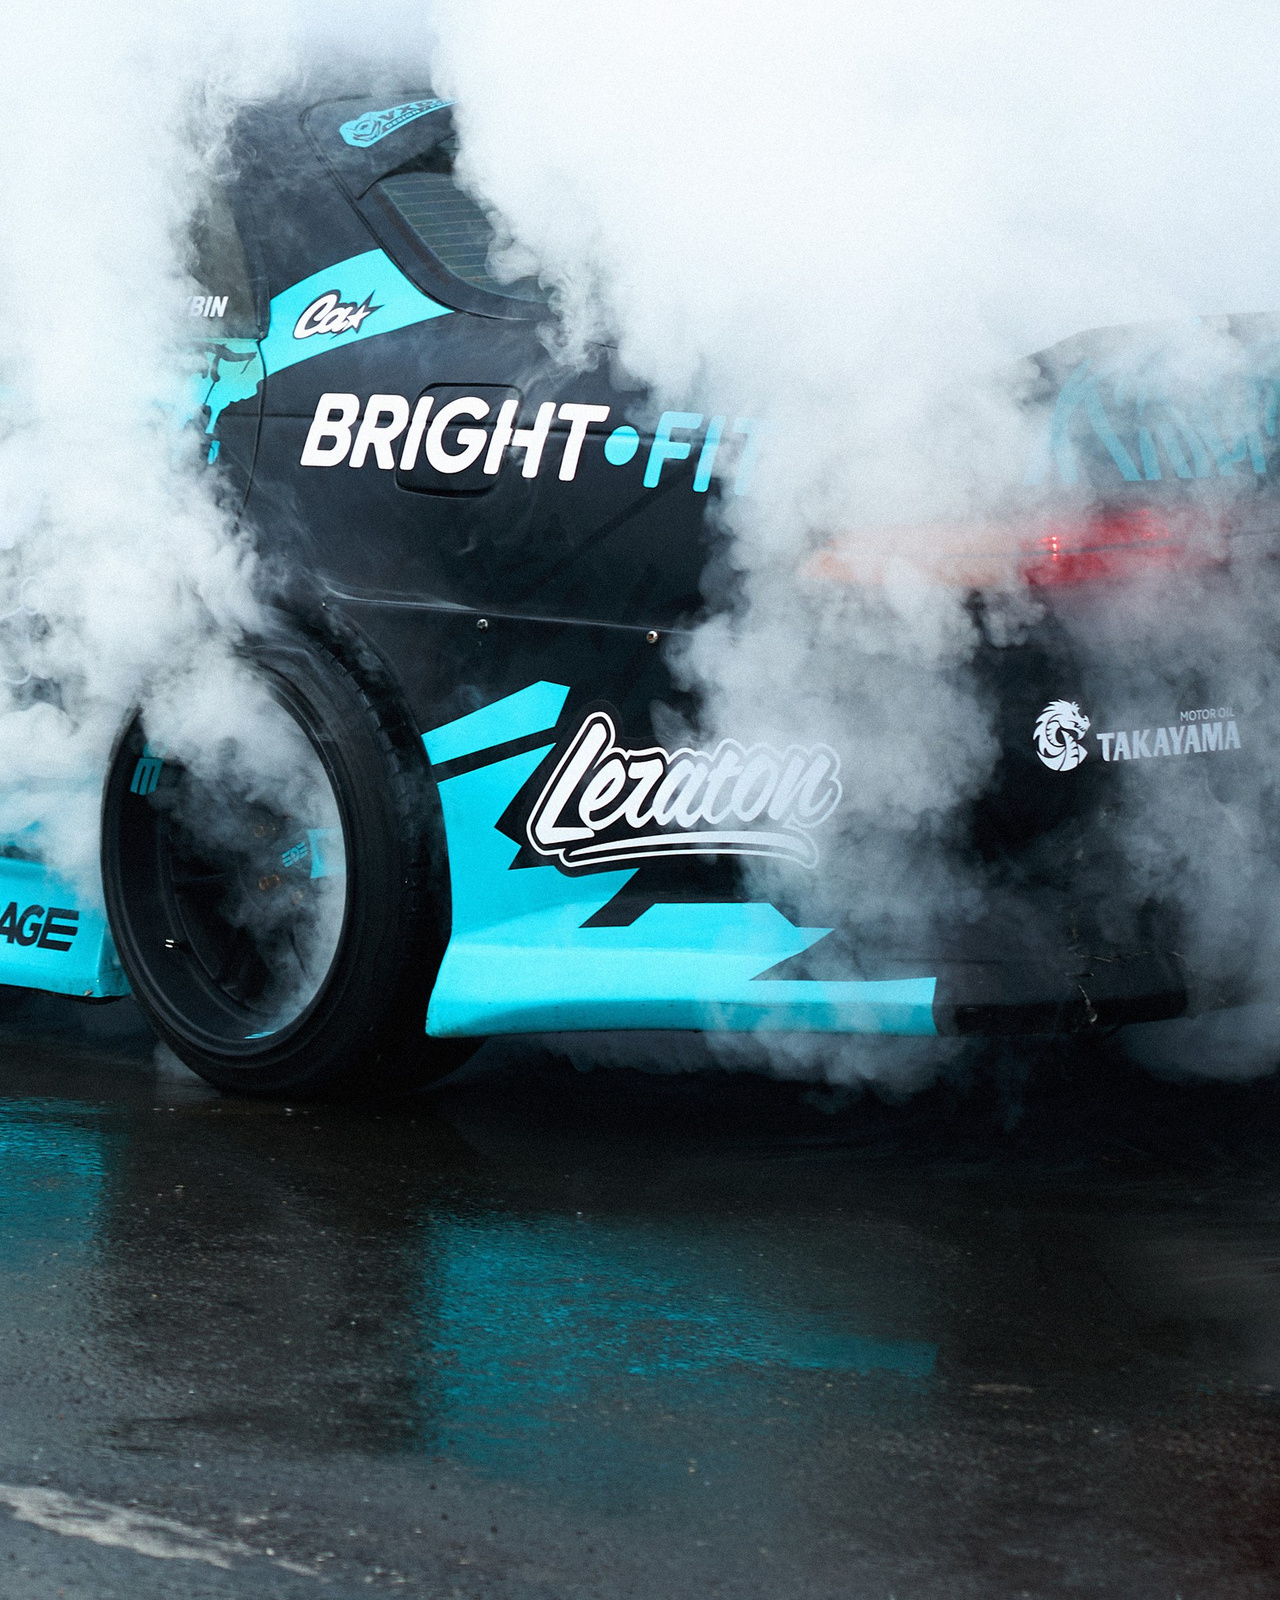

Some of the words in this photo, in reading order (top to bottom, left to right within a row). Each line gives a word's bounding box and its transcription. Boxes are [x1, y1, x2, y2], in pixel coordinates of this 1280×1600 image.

[300, 393, 611, 482] BRIGHT
[1179, 710, 1217, 722] MOTOR
[1218, 707, 1235, 718] OIL
[1096, 721, 1242, 762] TAKAYAMA
